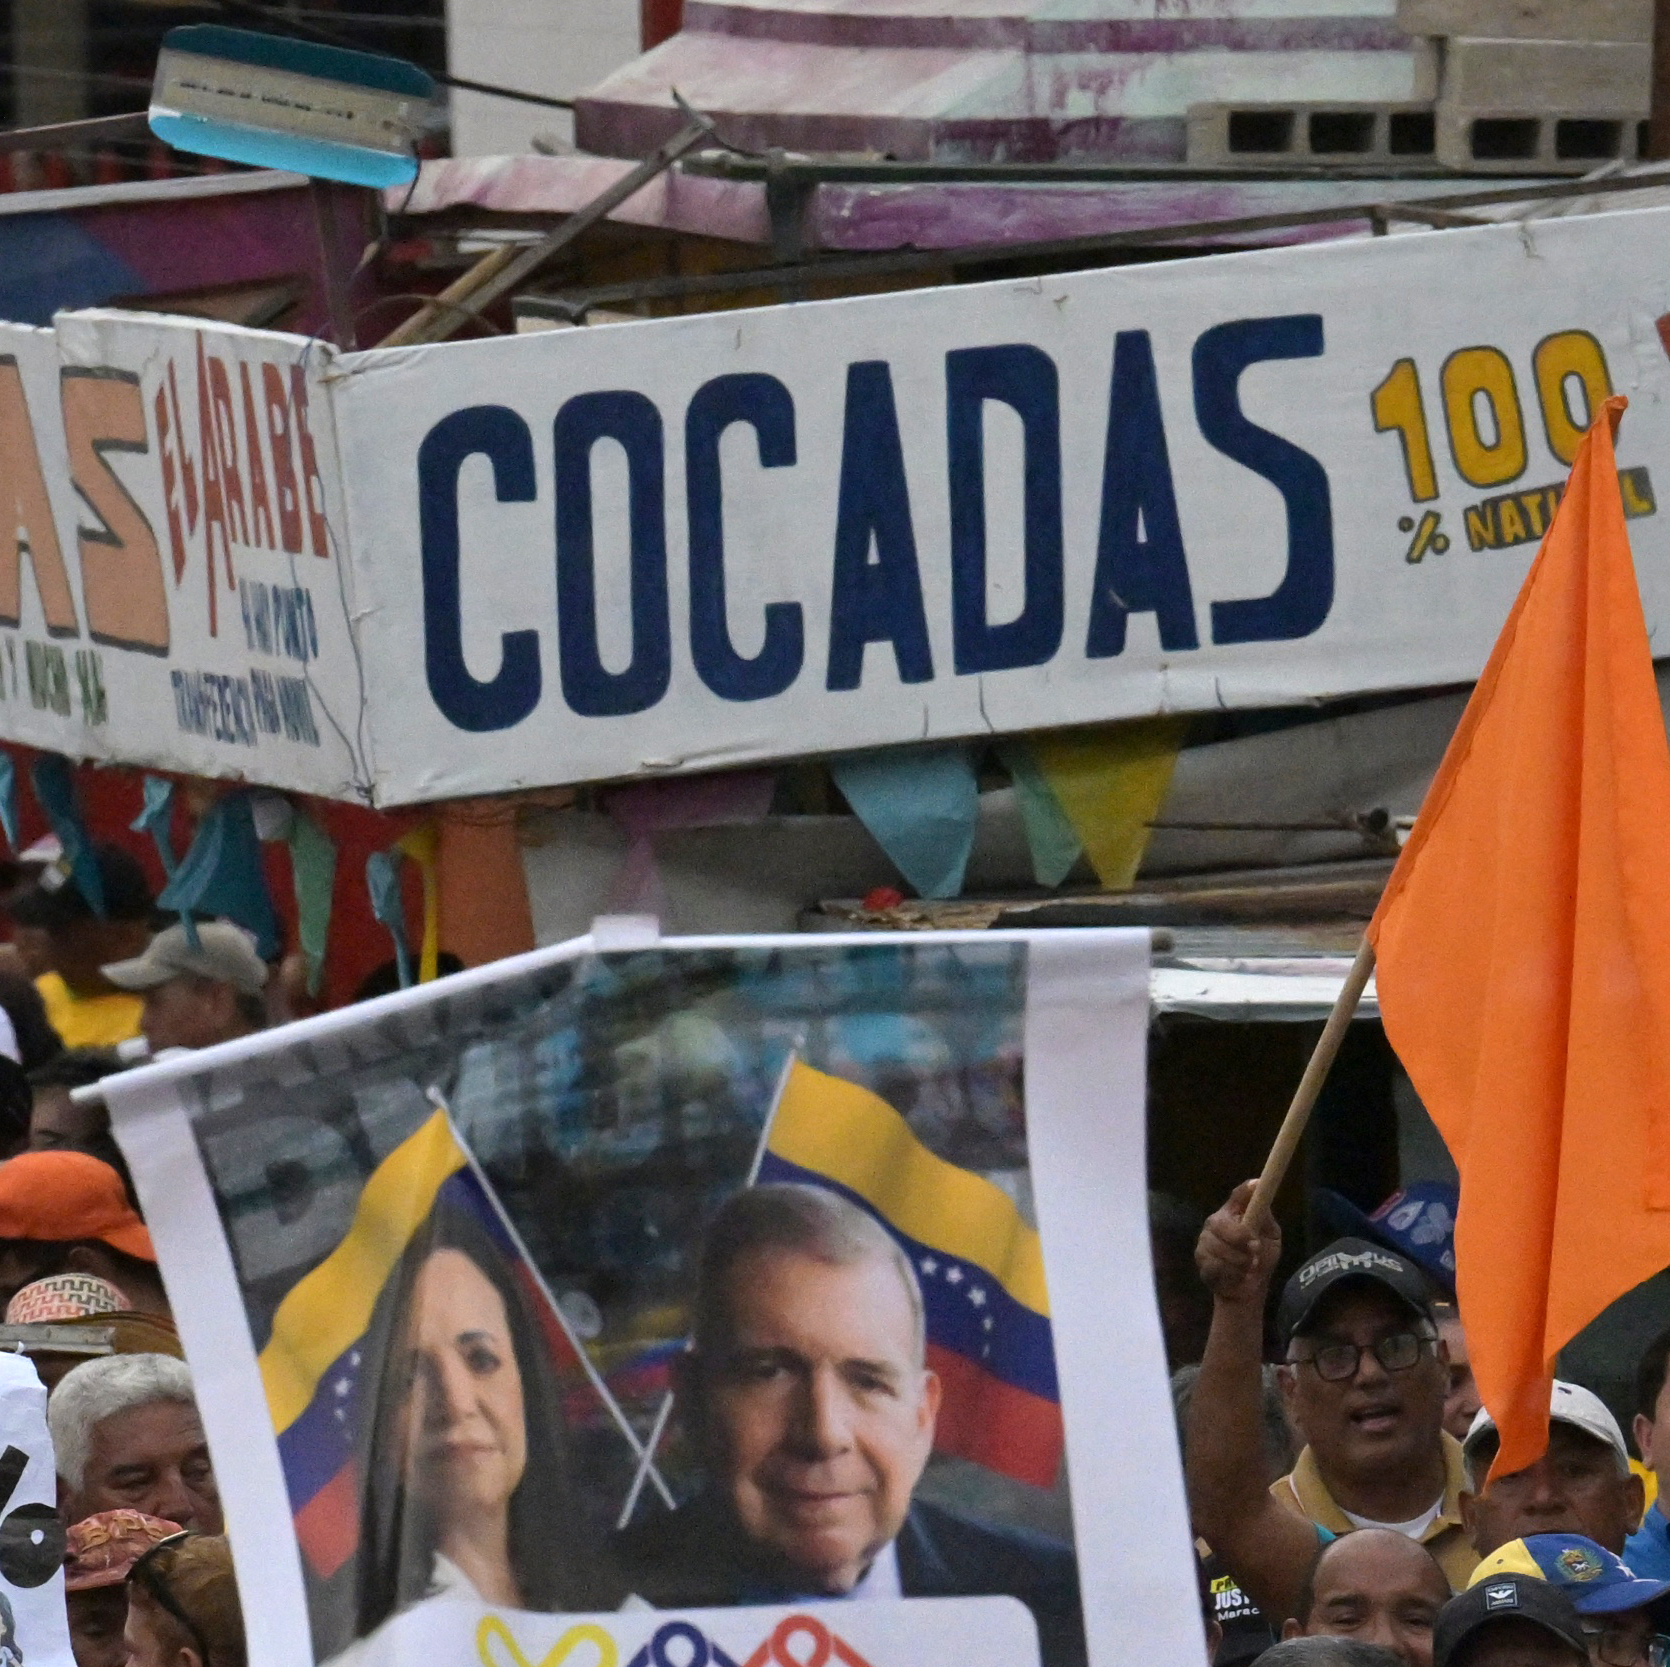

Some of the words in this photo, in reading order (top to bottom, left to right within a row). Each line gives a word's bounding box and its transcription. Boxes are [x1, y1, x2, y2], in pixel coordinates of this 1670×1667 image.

[154, 358, 197, 587] EL
[196, 330, 330, 636] ARABE
[418, 313, 1333, 731] COCADAS
[1370, 330, 1619, 503] 100
[1464, 466, 1657, 552] NATL
